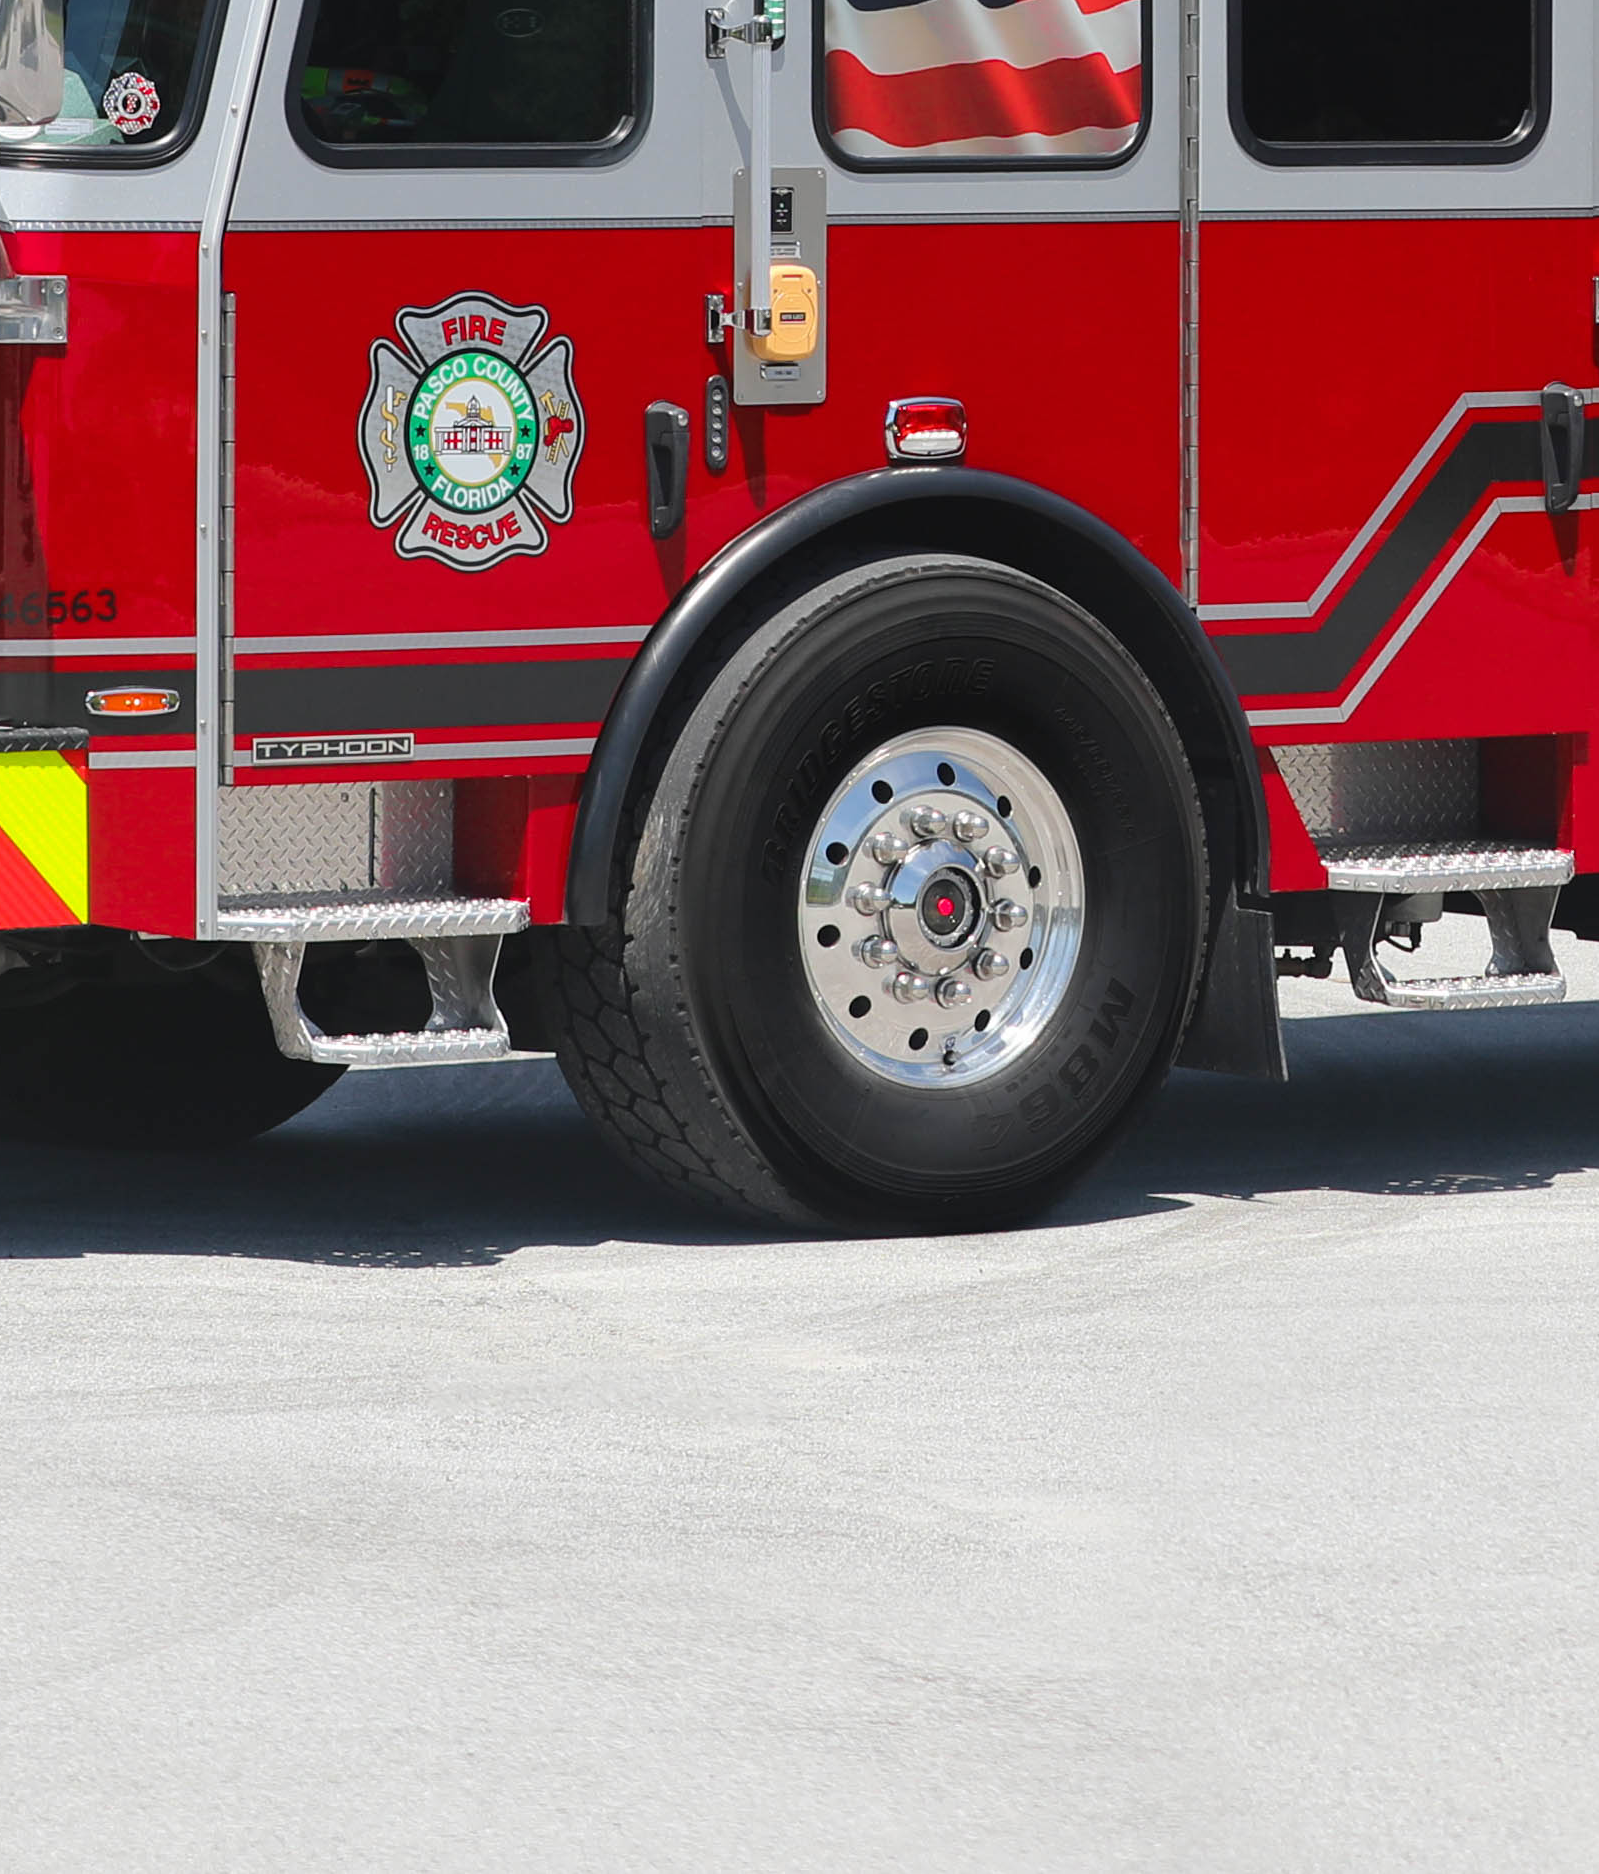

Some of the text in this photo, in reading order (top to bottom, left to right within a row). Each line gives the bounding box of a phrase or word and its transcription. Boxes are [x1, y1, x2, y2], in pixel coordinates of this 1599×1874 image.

[441, 314, 508, 346] FIRE
[412, 355, 536, 423] PASCO COUNTY
[413, 443, 533, 462] 18 87
[431, 475, 516, 509] FLORIDA
[421, 510, 522, 550] RESCUE
[257, 738, 410, 758] TYPHOON
[761, 656, 998, 888] BRIDGESTONE
